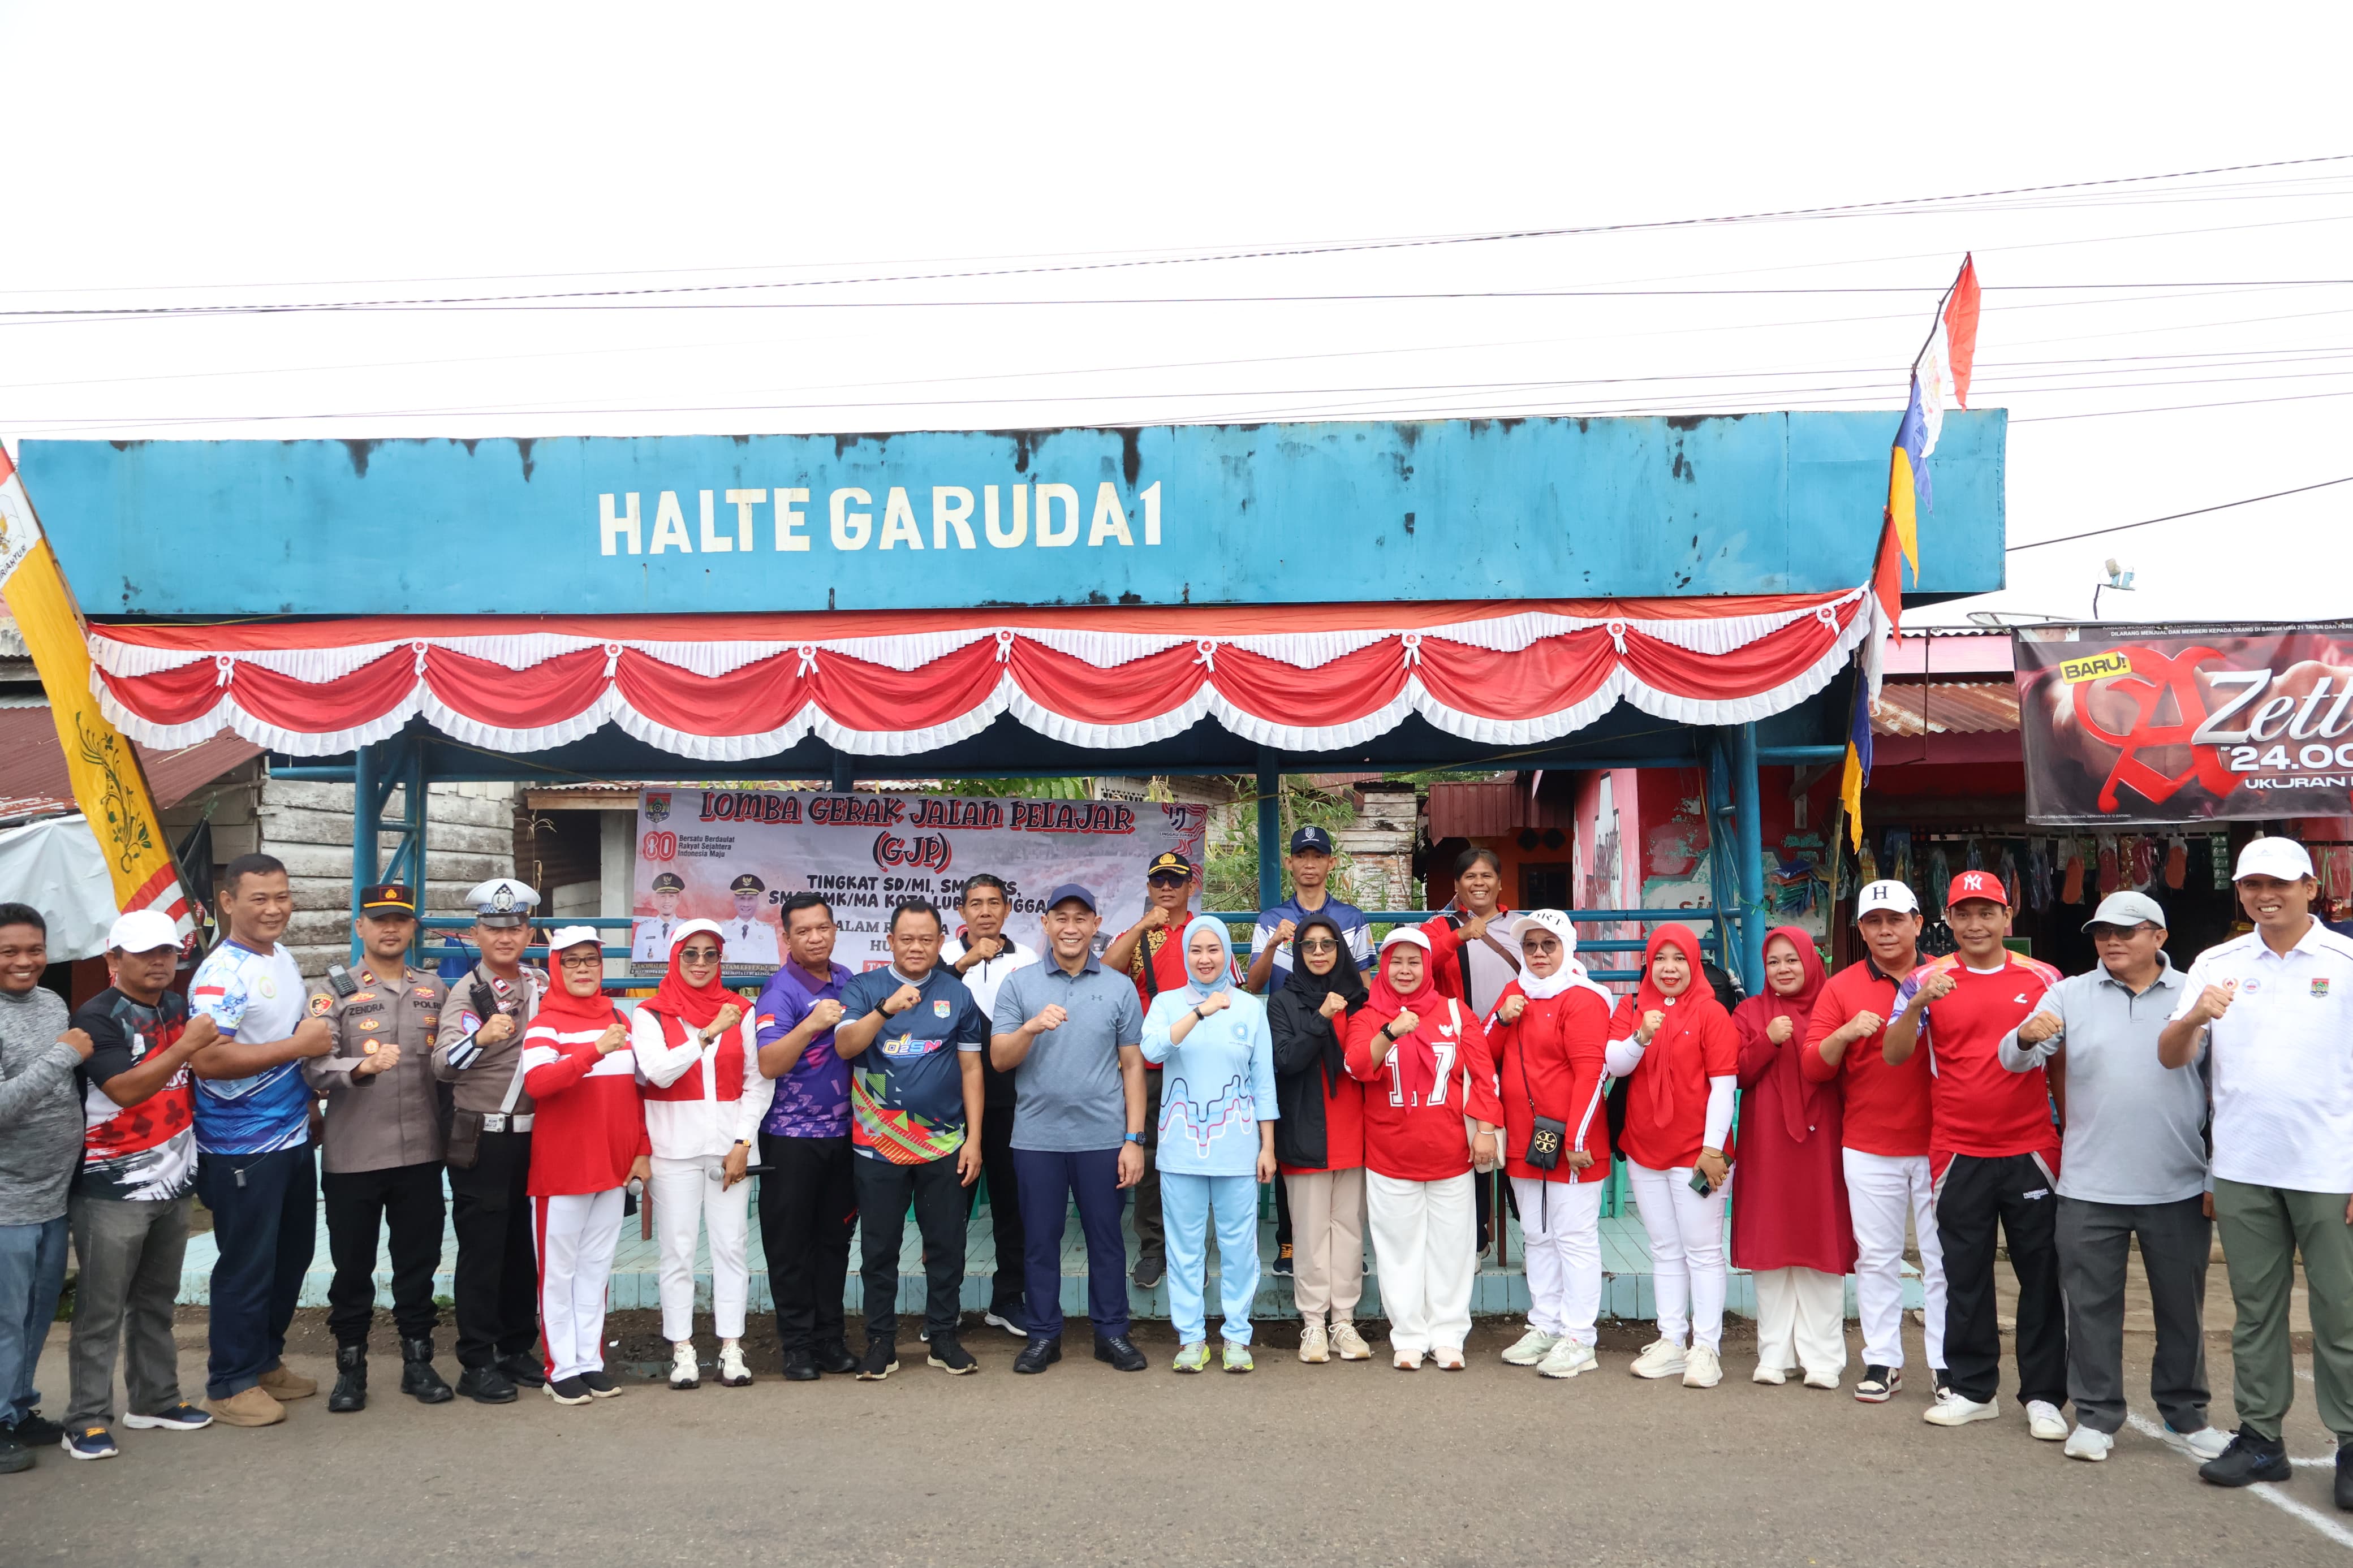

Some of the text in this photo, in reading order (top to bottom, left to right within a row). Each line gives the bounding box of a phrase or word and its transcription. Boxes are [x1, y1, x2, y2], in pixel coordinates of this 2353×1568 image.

[598, 488, 811, 556] HALTE
[830, 482, 1134, 551] GARUDA
[2064, 656, 2127, 680] BARU!
[2244, 776, 2346, 789] UKURAN
[699, 792, 1136, 835] LOMBA GERAK JALAN PELAJAR
[643, 831, 677, 861] 80
[678, 842, 700, 851] Rakyat
[807, 875, 879, 891] TINGKAT
[883, 877, 934, 895] SD/MI,
[1963, 874, 1983, 891] NY
[1872, 885, 1889, 901] H
[835, 920, 880, 933] ALAM
[349, 1003, 385, 1016] ZENDRA
[413, 1000, 442, 1010] POLRI
